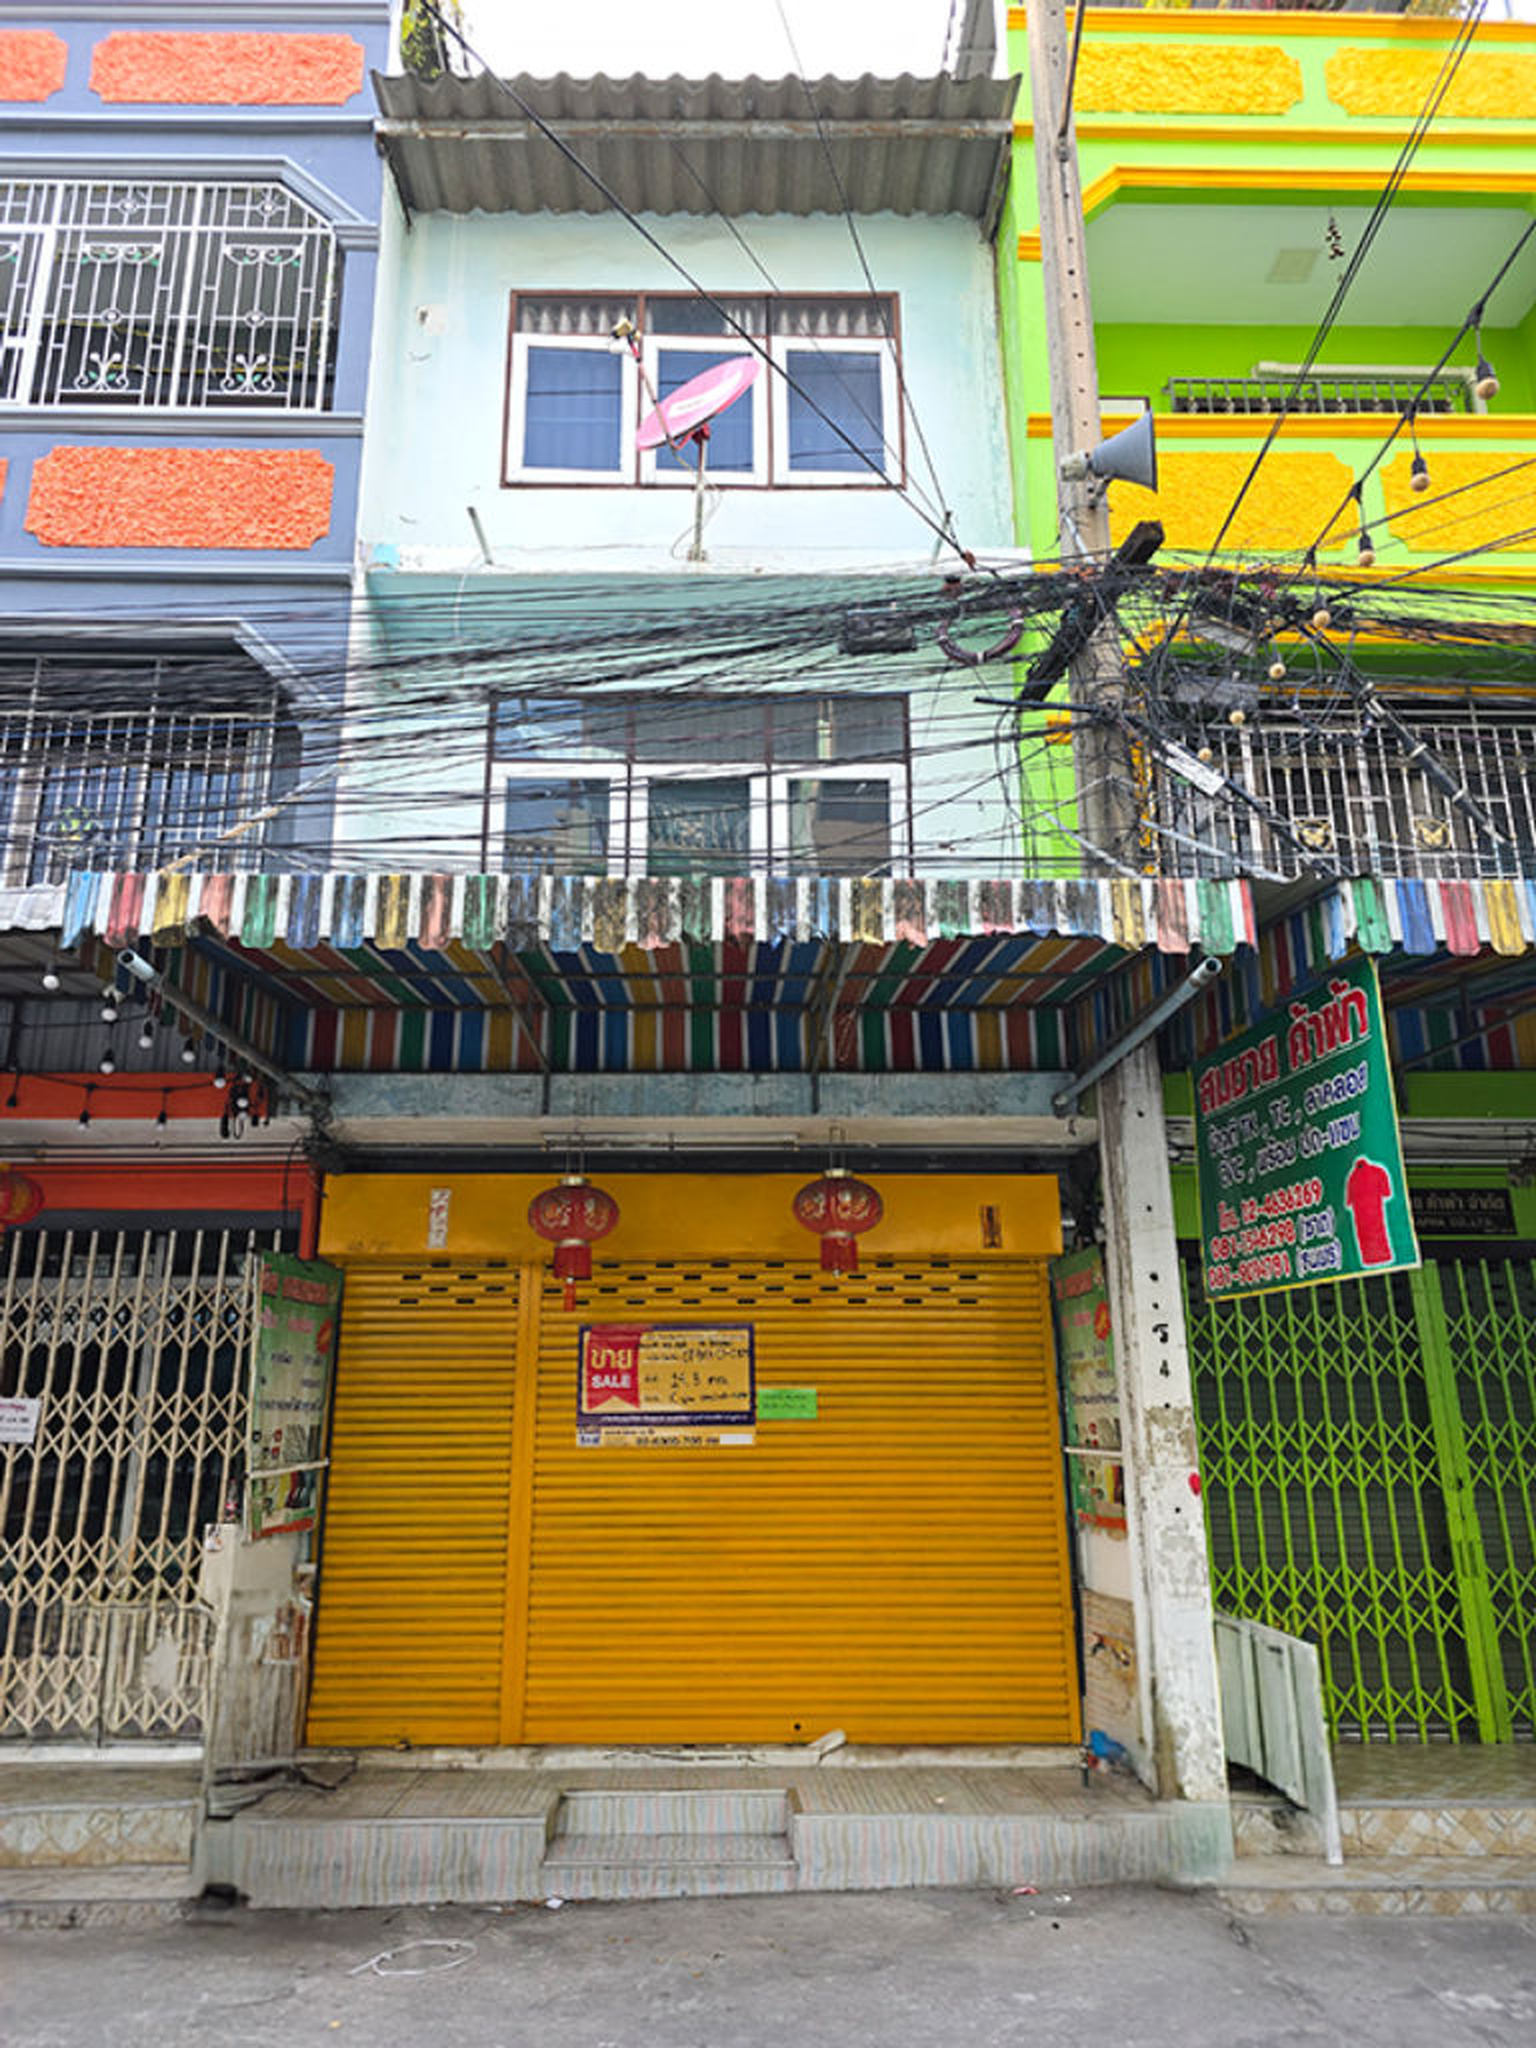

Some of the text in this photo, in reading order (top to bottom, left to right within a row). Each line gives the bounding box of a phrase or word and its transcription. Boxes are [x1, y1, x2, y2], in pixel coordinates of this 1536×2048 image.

[1199, 978, 1368, 1115] สมชาย ค้าผ้า
[591, 1349, 633, 1369] ขาย
[591, 1374, 631, 1389] SALE
